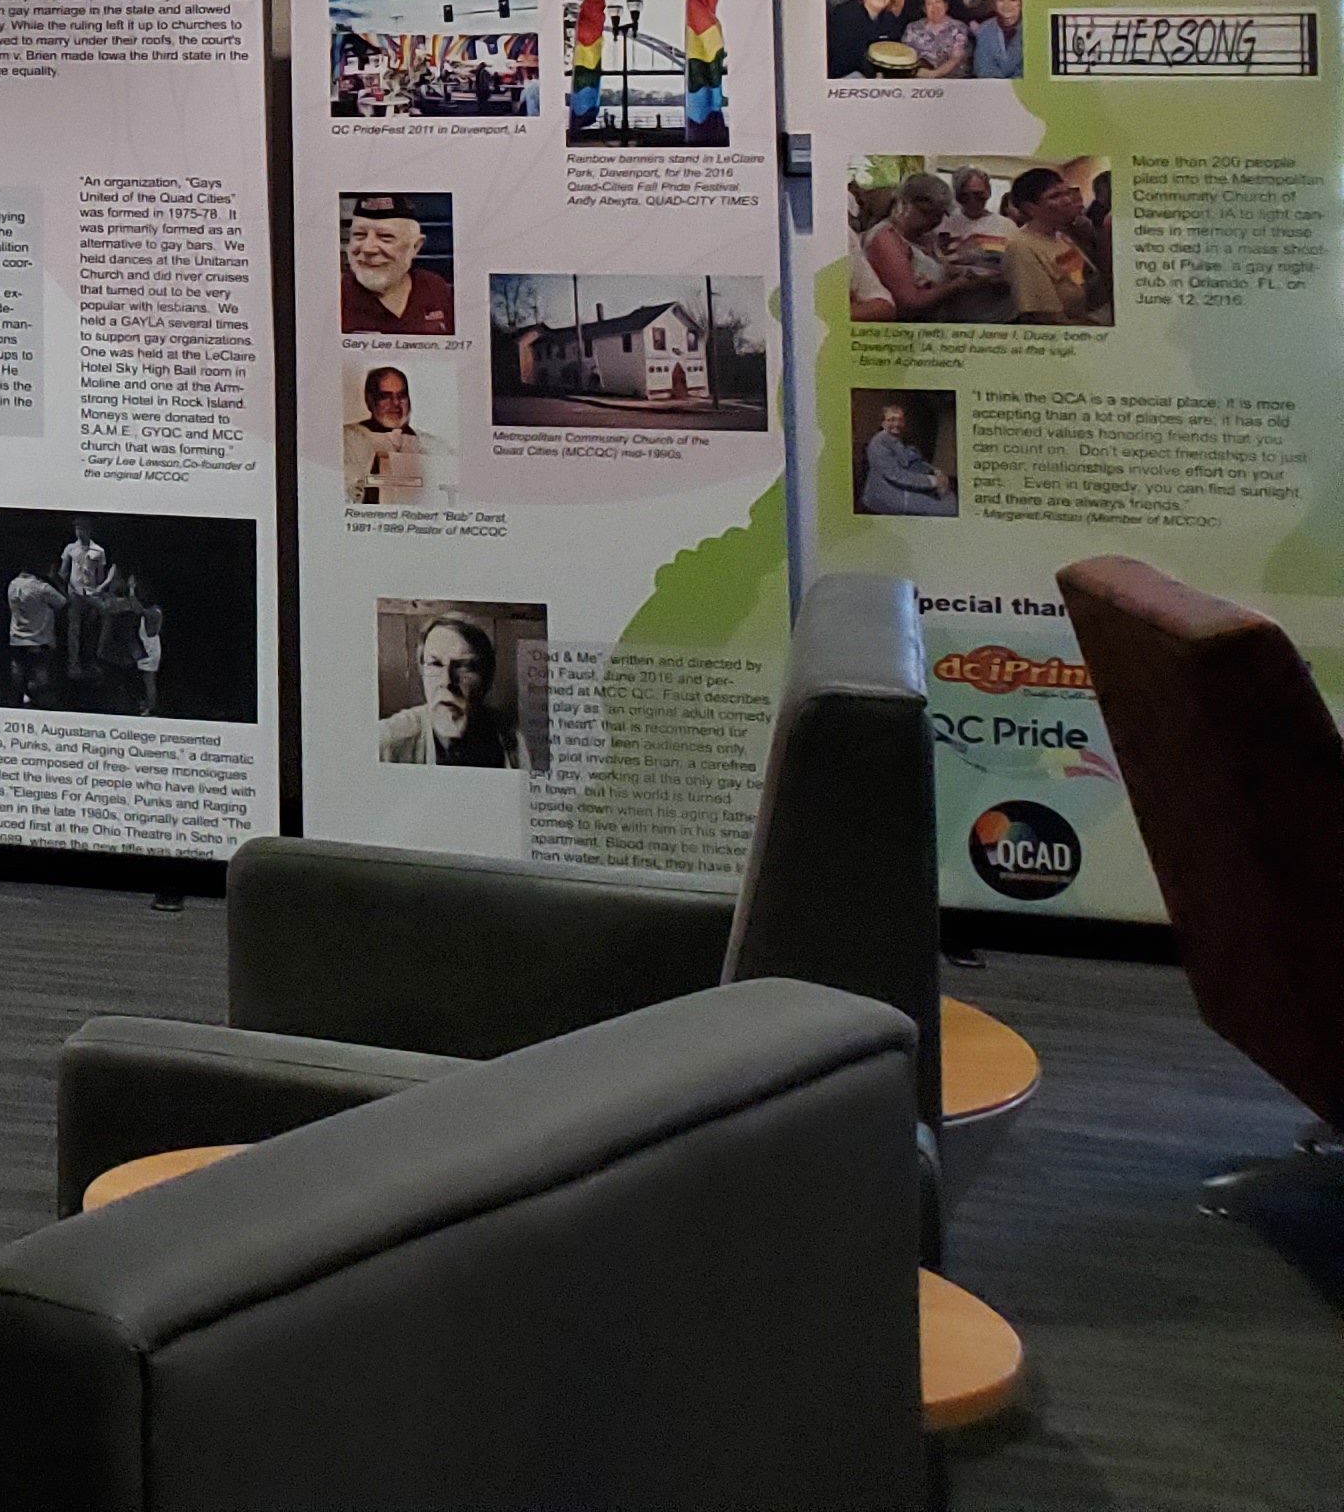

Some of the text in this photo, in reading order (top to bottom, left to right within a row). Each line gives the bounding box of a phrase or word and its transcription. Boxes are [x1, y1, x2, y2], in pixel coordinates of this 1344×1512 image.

[1111, 18, 1256, 71] HERSONG
[910, 88, 944, 98] 2009
[331, 124, 350, 134] QC
[351, 124, 405, 134] PrideFest
[407, 124, 434, 134] 2011
[437, 126, 448, 134] in
[341, 338, 370, 350] Gary
[371, 339, 392, 349] Lee
[444, 340, 472, 350] 2017
[914, 591, 1002, 615] pecial
[40, 723, 106, 741] Augustana
[109, 728, 157, 744] College
[159, 732, 221, 747] presented
[993, 717, 1089, 749] Pride
[997, 840, 1071, 871] QCAD
